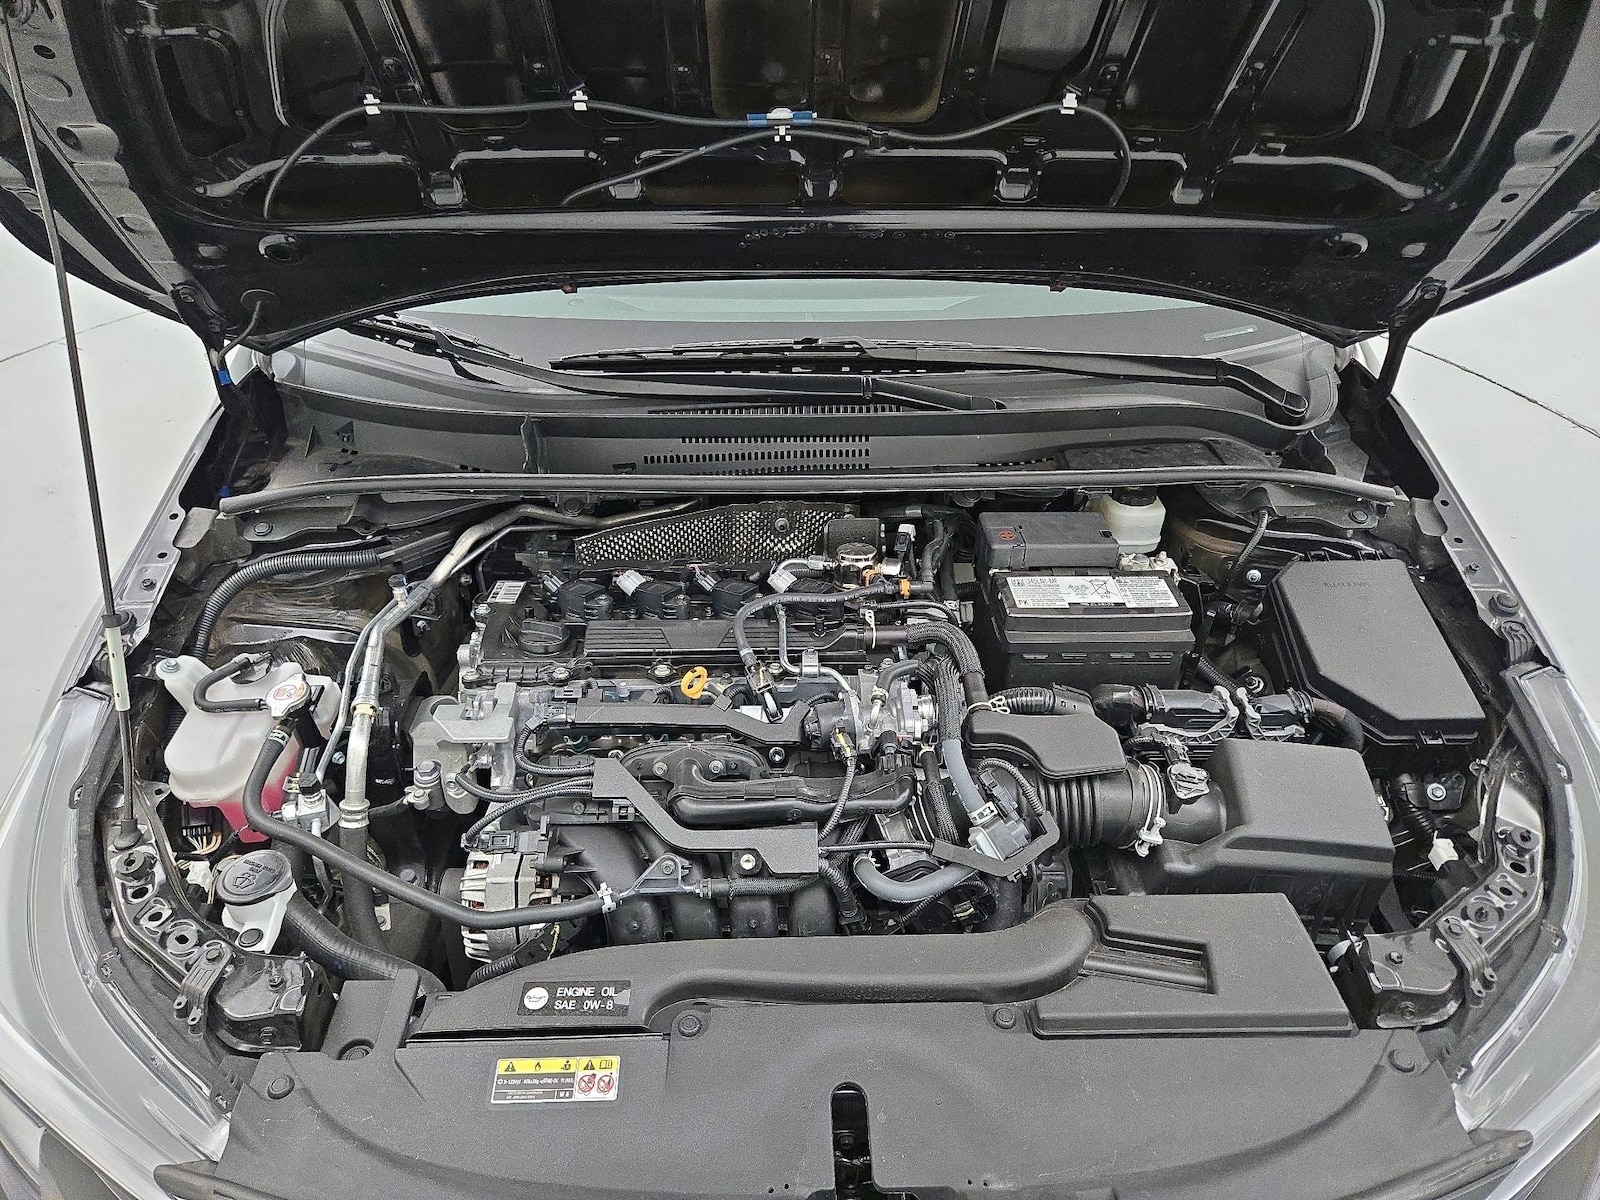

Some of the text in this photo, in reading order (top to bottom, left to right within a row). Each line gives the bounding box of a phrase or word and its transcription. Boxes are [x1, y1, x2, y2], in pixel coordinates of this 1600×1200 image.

[556, 986, 618, 997] ENGINE OIL
[554, 999, 614, 1010] SAE 0W-8
